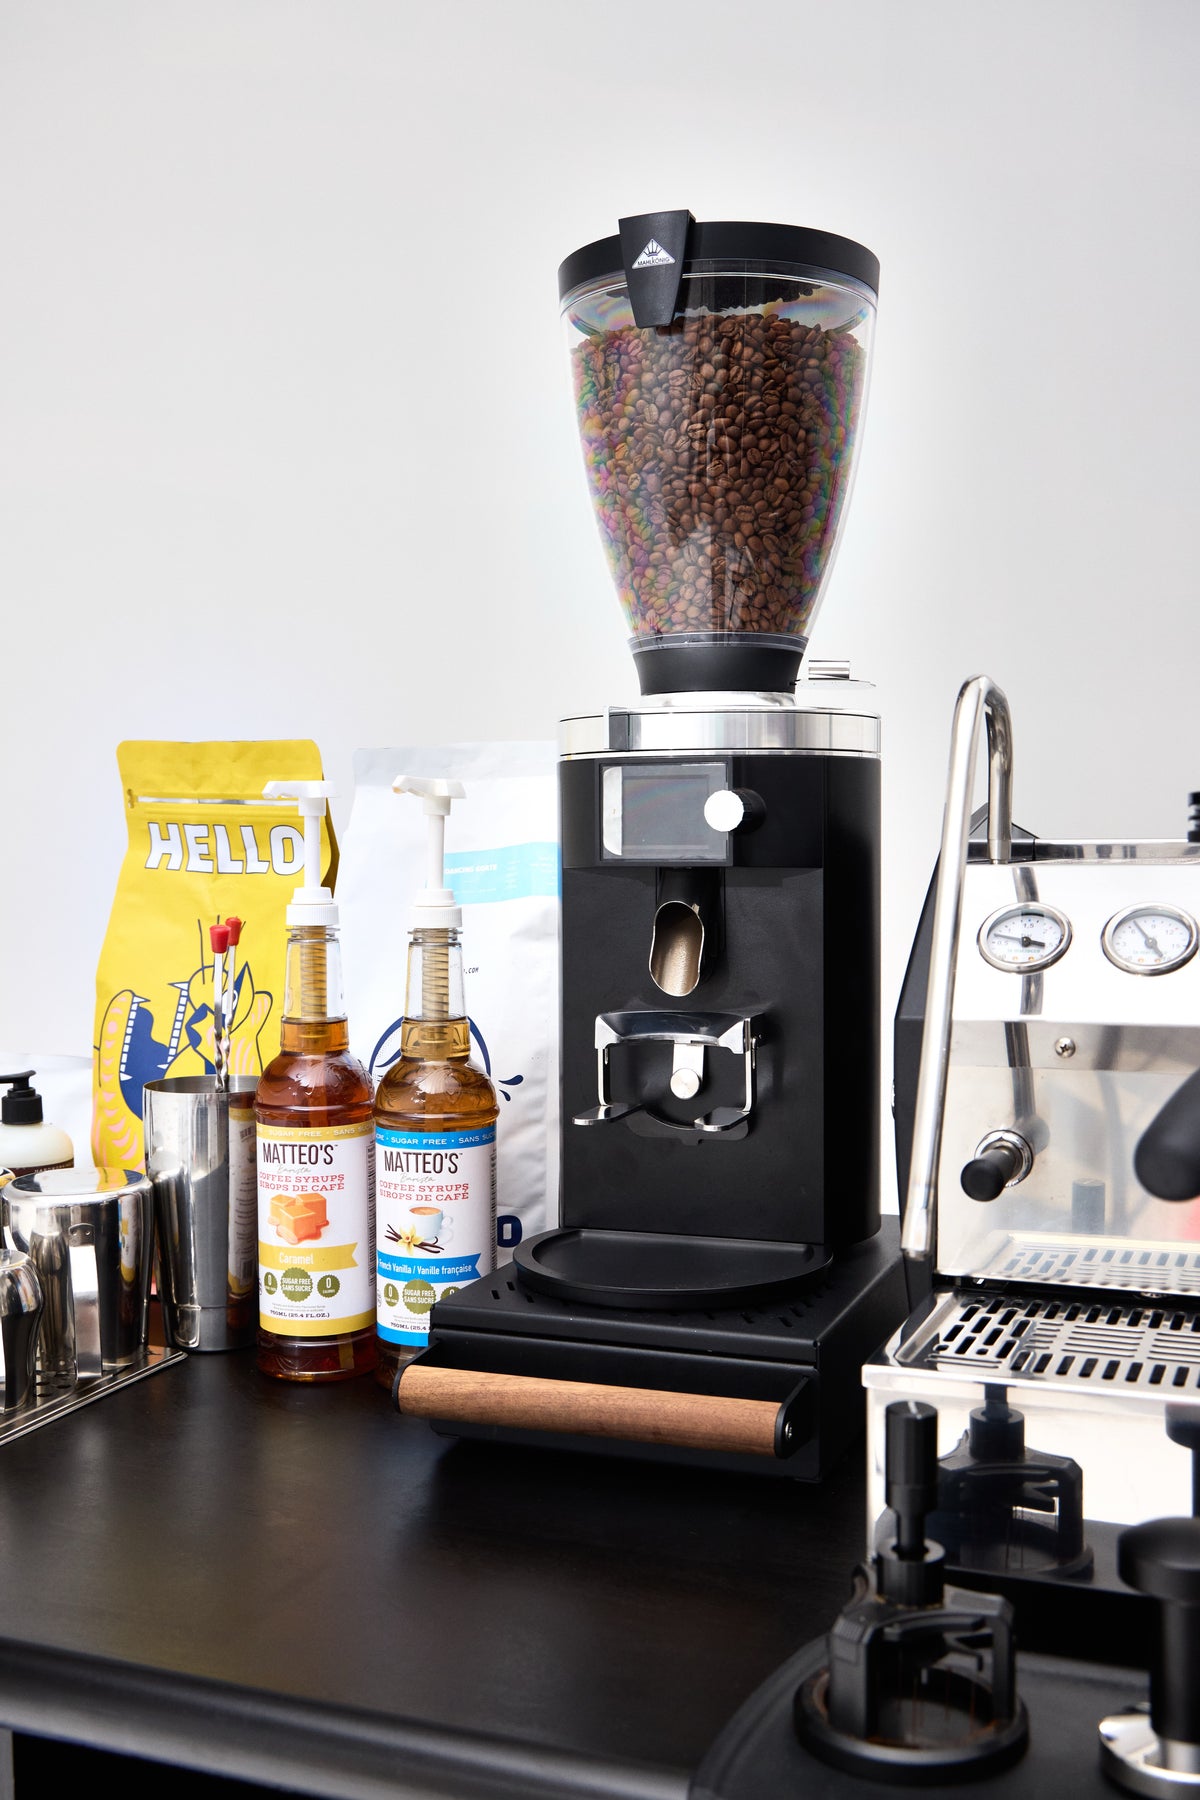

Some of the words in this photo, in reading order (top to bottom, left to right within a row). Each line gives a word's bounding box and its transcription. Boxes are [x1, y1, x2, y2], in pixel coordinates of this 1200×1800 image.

[144, 821, 306, 876] HELLO
[333, 1128, 355, 1136] SANS
[390, 1137, 419, 1145] SUGAR
[458, 1135, 480, 1144] SANS
[262, 1143, 335, 1165] MATTEO'S
[384, 1150, 459, 1174] MATTEO'S
[259, 1171, 292, 1183] COFFEE
[294, 1173, 345, 1184] SYRUPS
[259, 1180, 289, 1192] SIROPS
[292, 1184, 308, 1192] DE
[380, 1180, 415, 1192] COFFEE
[418, 1183, 469, 1192] SYRUPS
[380, 1190, 412, 1201] SIROPS
[416, 1194, 432, 1202] DE
[279, 1252, 314, 1265] Caramel
[392, 1263, 412, 1274] Vanilla
[417, 1266, 440, 1275] Vanille
[441, 1263, 472, 1276] française
[281, 1277, 298, 1285] SUGAR
[298, 1277, 312, 1285] FREE
[325, 1277, 332, 1289] 0
[404, 1289, 421, 1297] SUGAR
[421, 1289, 435, 1297] FREE
[270, 1309, 287, 1317] 750ML
[390, 1321, 409, 1330] 750ML
